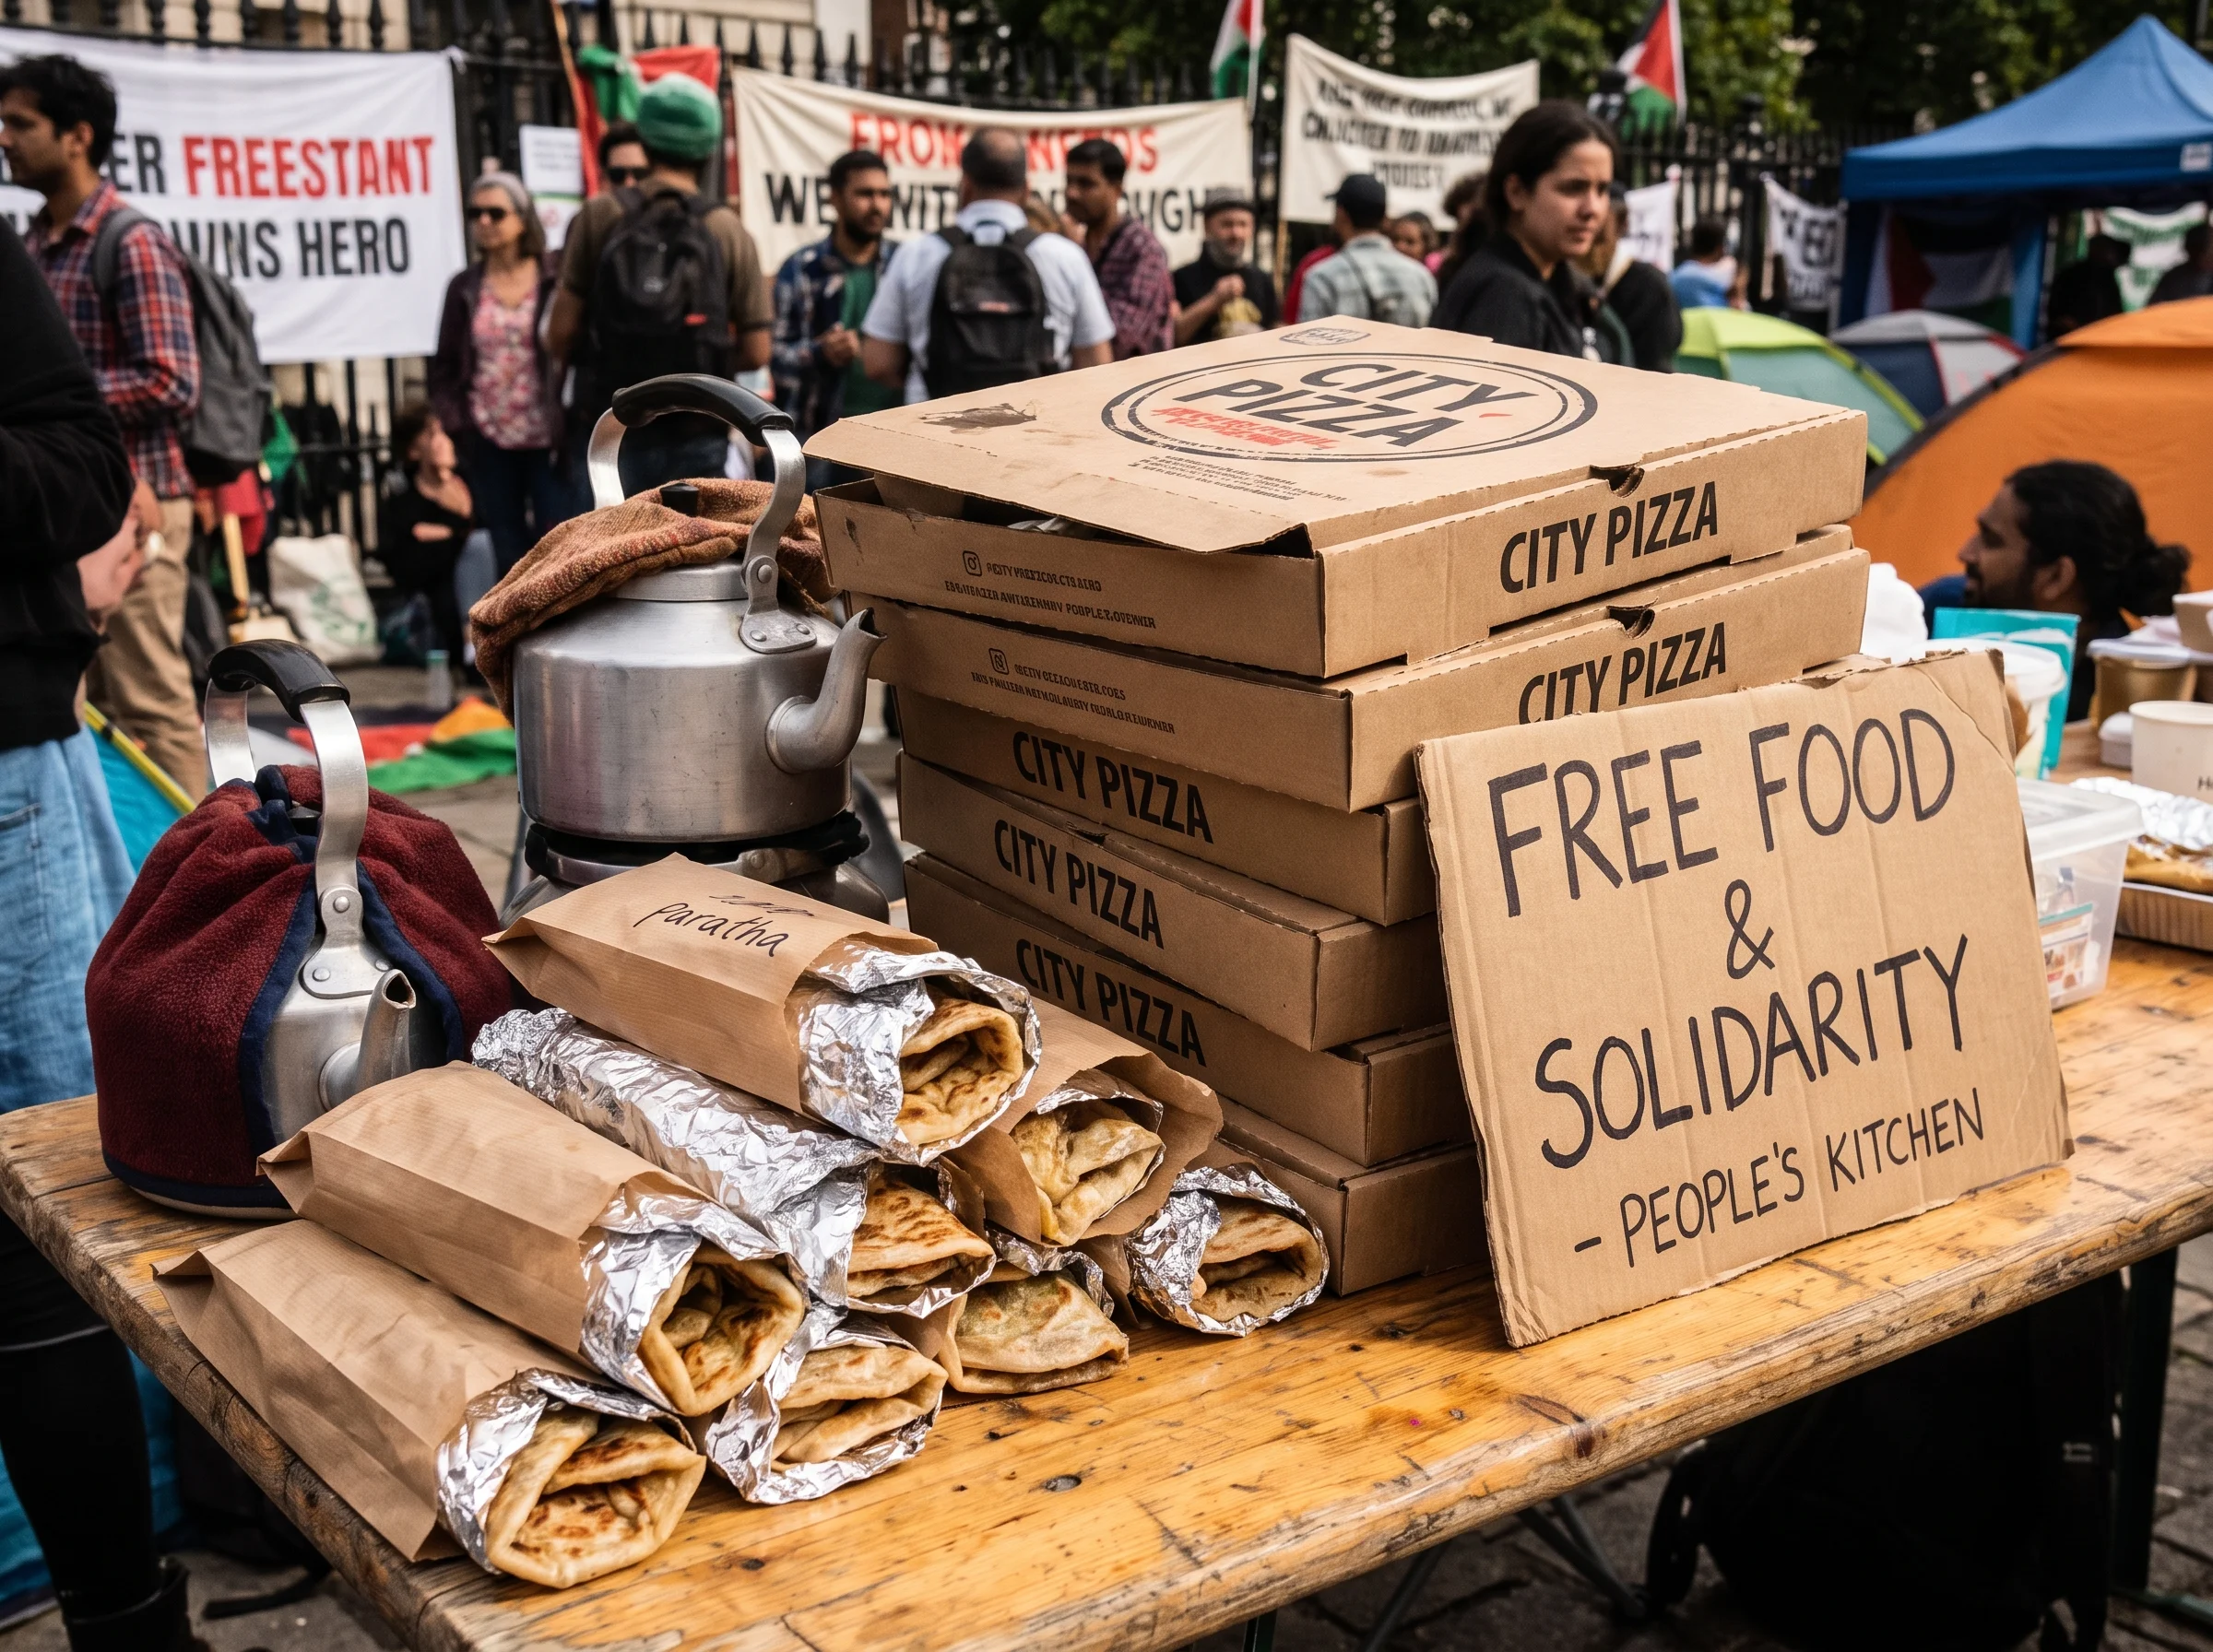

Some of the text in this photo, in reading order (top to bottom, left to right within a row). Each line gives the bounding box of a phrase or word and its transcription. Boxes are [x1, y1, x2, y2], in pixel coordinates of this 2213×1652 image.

[298, 217, 411, 278] HERO
[1172, 378, 1465, 448] PIZZA
[1299, 363, 1538, 412] CITY
[1499, 480, 1718, 594] CITY PIZZA
[1518, 621, 1726, 726] CITY PIZZA
[1012, 731, 1214, 845] CITY PIZZA
[1486, 708, 1956, 918] FREE FOOD
[994, 819, 1166, 950] CITY PIZZA
[1723, 879, 1776, 980] &
[1015, 938, 1208, 1068] CITY PIZZA
[1534, 933, 1969, 1170] SOLIDARITY
[1619, 1141, 1805, 1268] PEOPLE'S
[1825, 1087, 1984, 1193] KITCHEN
